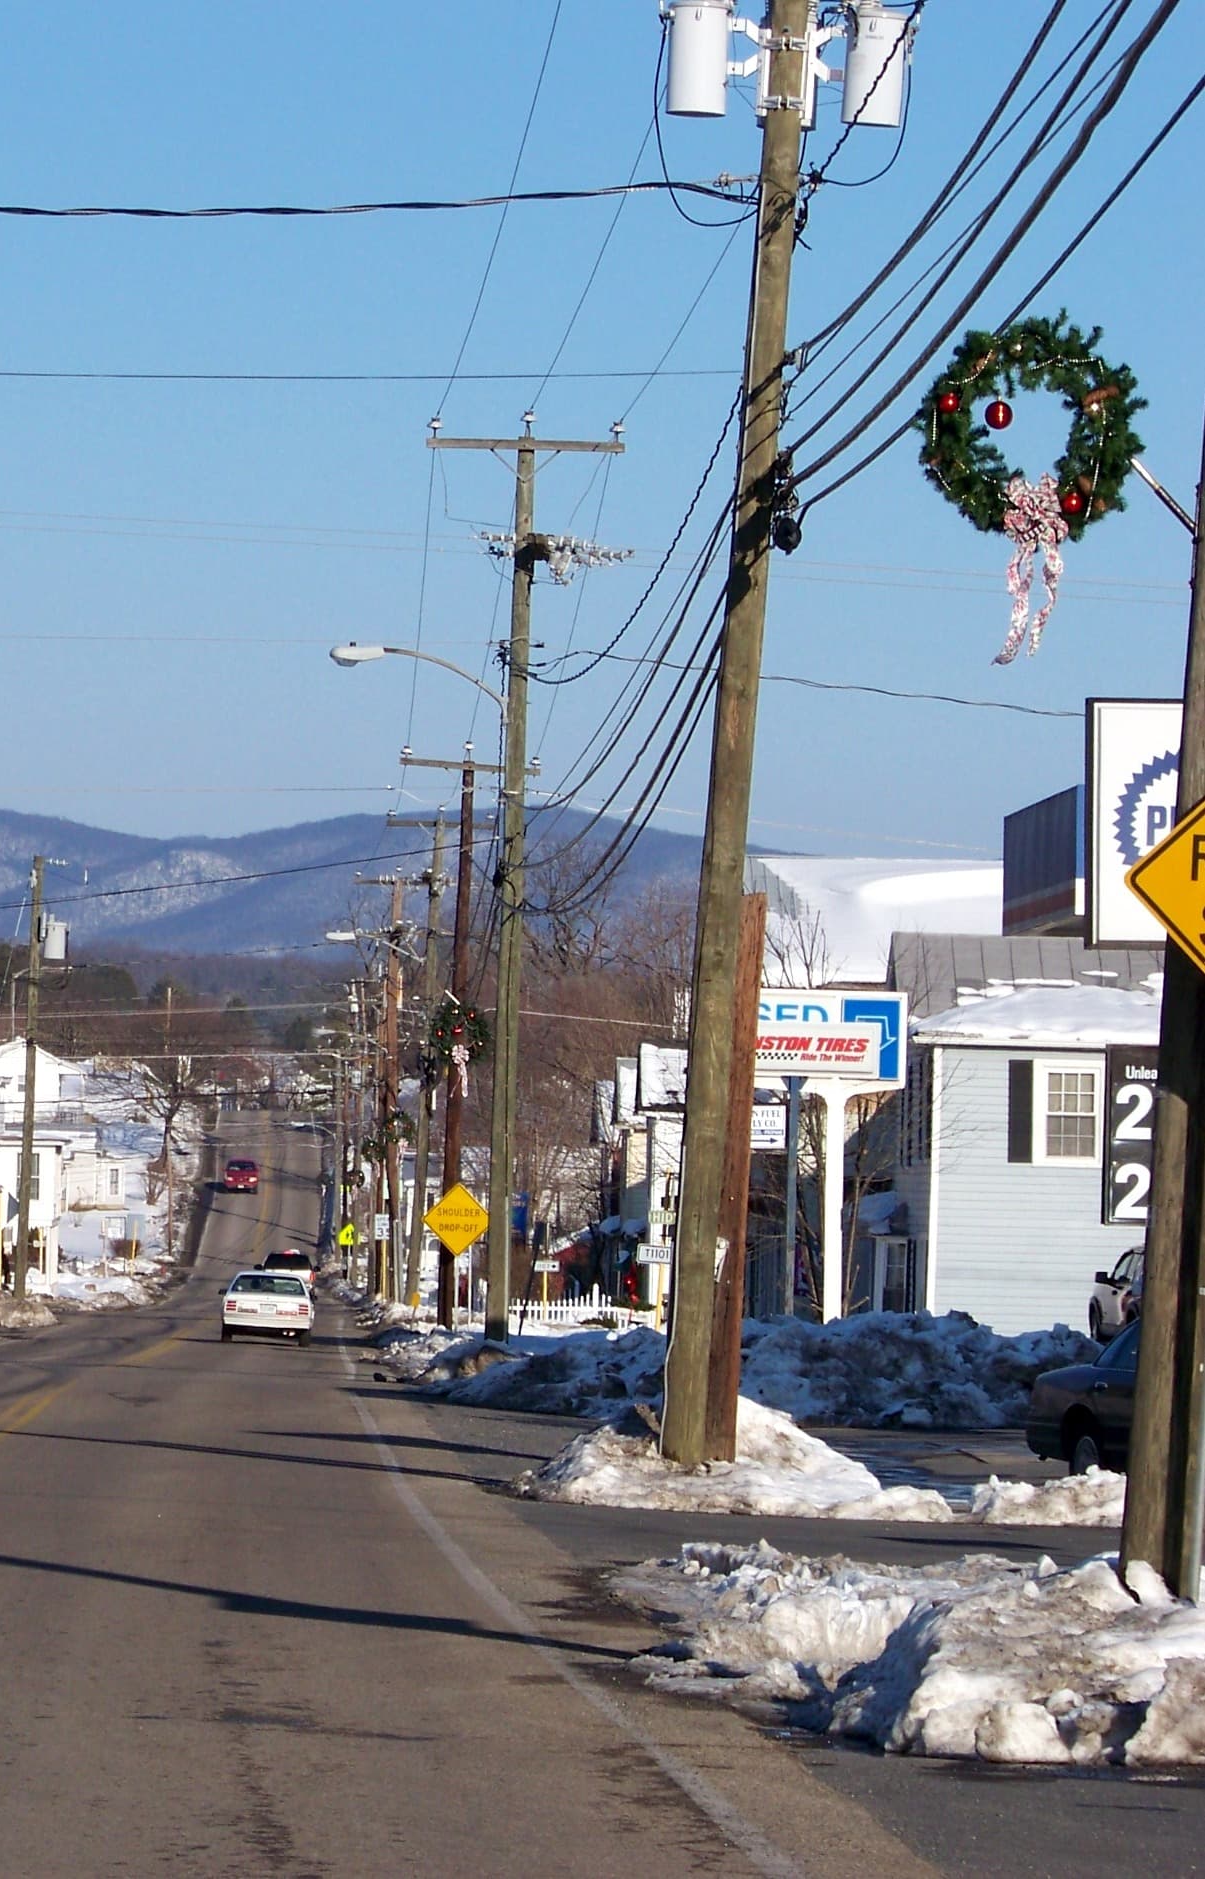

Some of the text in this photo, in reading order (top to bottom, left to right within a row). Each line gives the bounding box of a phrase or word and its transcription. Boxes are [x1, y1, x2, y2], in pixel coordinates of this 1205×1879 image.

[1147, 805, 1177, 846] P
[816, 1037, 869, 1053] TIRES
[800, 1053, 817, 1062] Ride
[819, 1053, 832, 1062] The
[1116, 1084, 1153, 1140] 2
[1115, 1163, 1151, 1219] 2
[437, 1207, 480, 1217] SHOULDER
[438, 1223, 478, 1233] DROP-OFF
